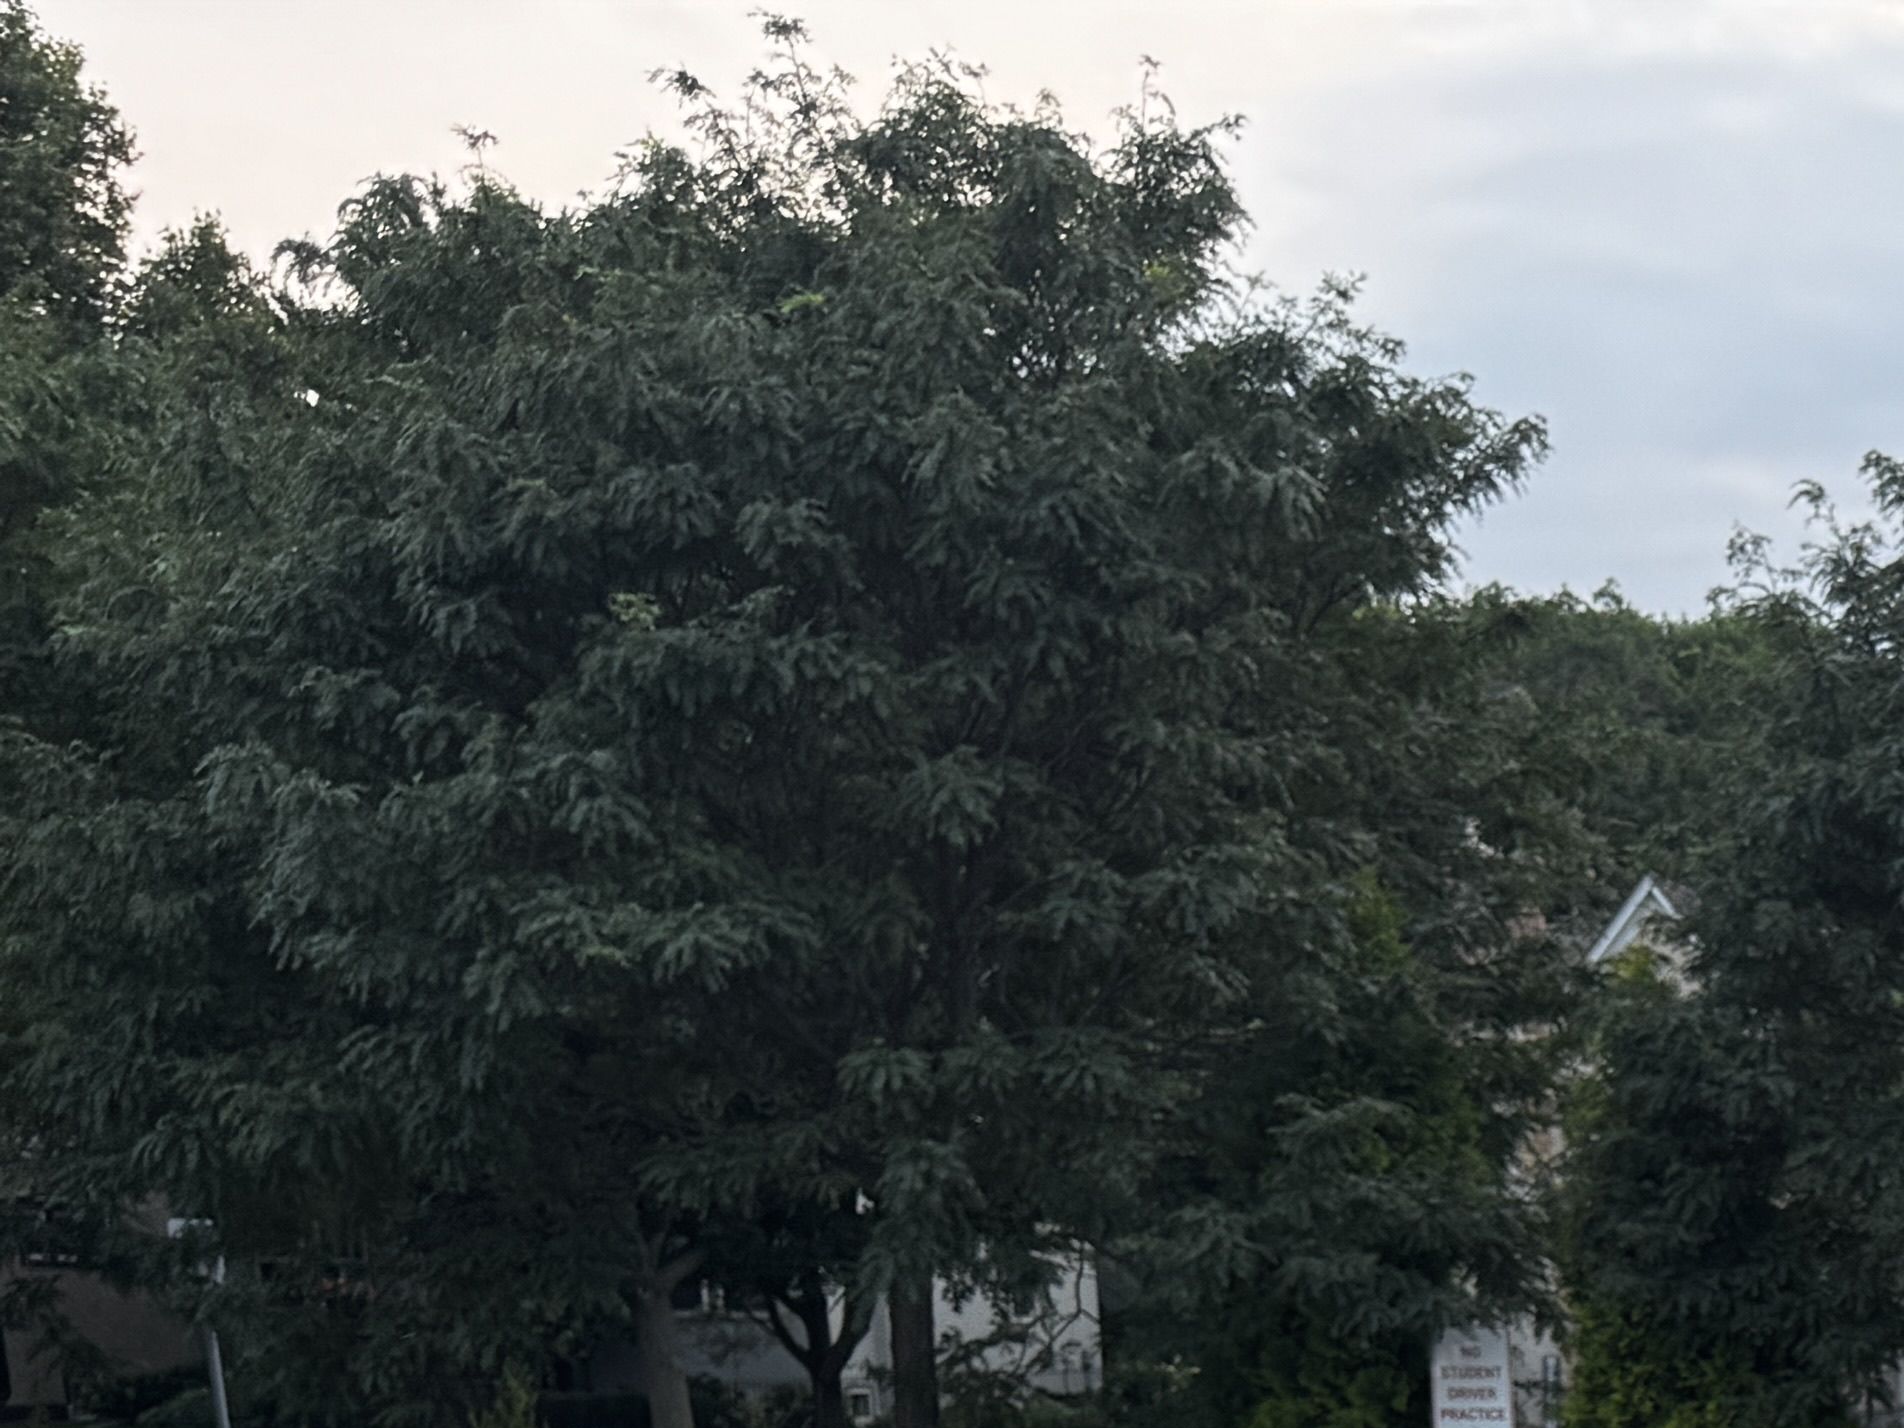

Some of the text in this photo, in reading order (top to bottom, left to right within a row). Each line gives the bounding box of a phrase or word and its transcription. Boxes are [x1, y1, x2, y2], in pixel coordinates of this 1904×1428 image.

[1460, 1345, 1481, 1358] NO
[1441, 1365, 1501, 1379] STUDENT
[1447, 1386, 1497, 1400] DRIVER
[1440, 1407, 1505, 1421] PRACTICE
